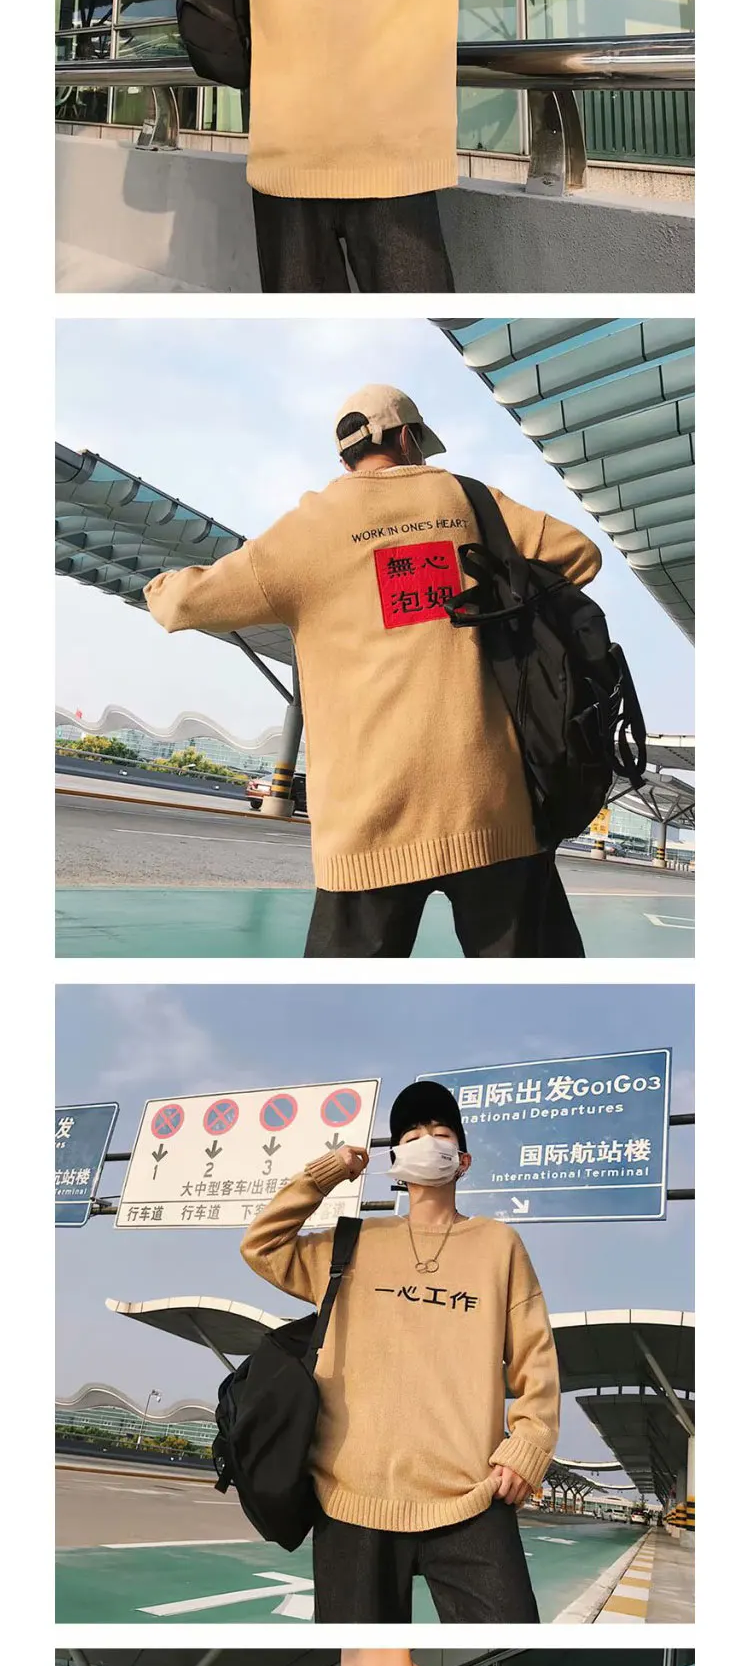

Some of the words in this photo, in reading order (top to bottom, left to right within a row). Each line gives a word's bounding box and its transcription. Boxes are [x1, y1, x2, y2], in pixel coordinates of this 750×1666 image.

[351, 528, 386, 544] WORK
[387, 526, 399, 536] IN
[400, 520, 434, 534] ONE'S
[435, 518, 469, 530] HEART
[386, 555, 450, 579] 無心
[461, 1107, 527, 1124] national
[530, 1103, 624, 1119] Departures
[519, 1138, 652, 1167] 国际航站楼
[152, 1164, 159, 1181] 1
[203, 1162, 216, 1178] 2
[262, 1159, 273, 1176] 3
[491, 1170, 581, 1183] International
[584, 1166, 650, 1179] Terminal
[127, 1205, 165, 1222] 行车道
[181, 1204, 222, 1221] 行车道
[374, 1285, 479, 1313] 一心工作
